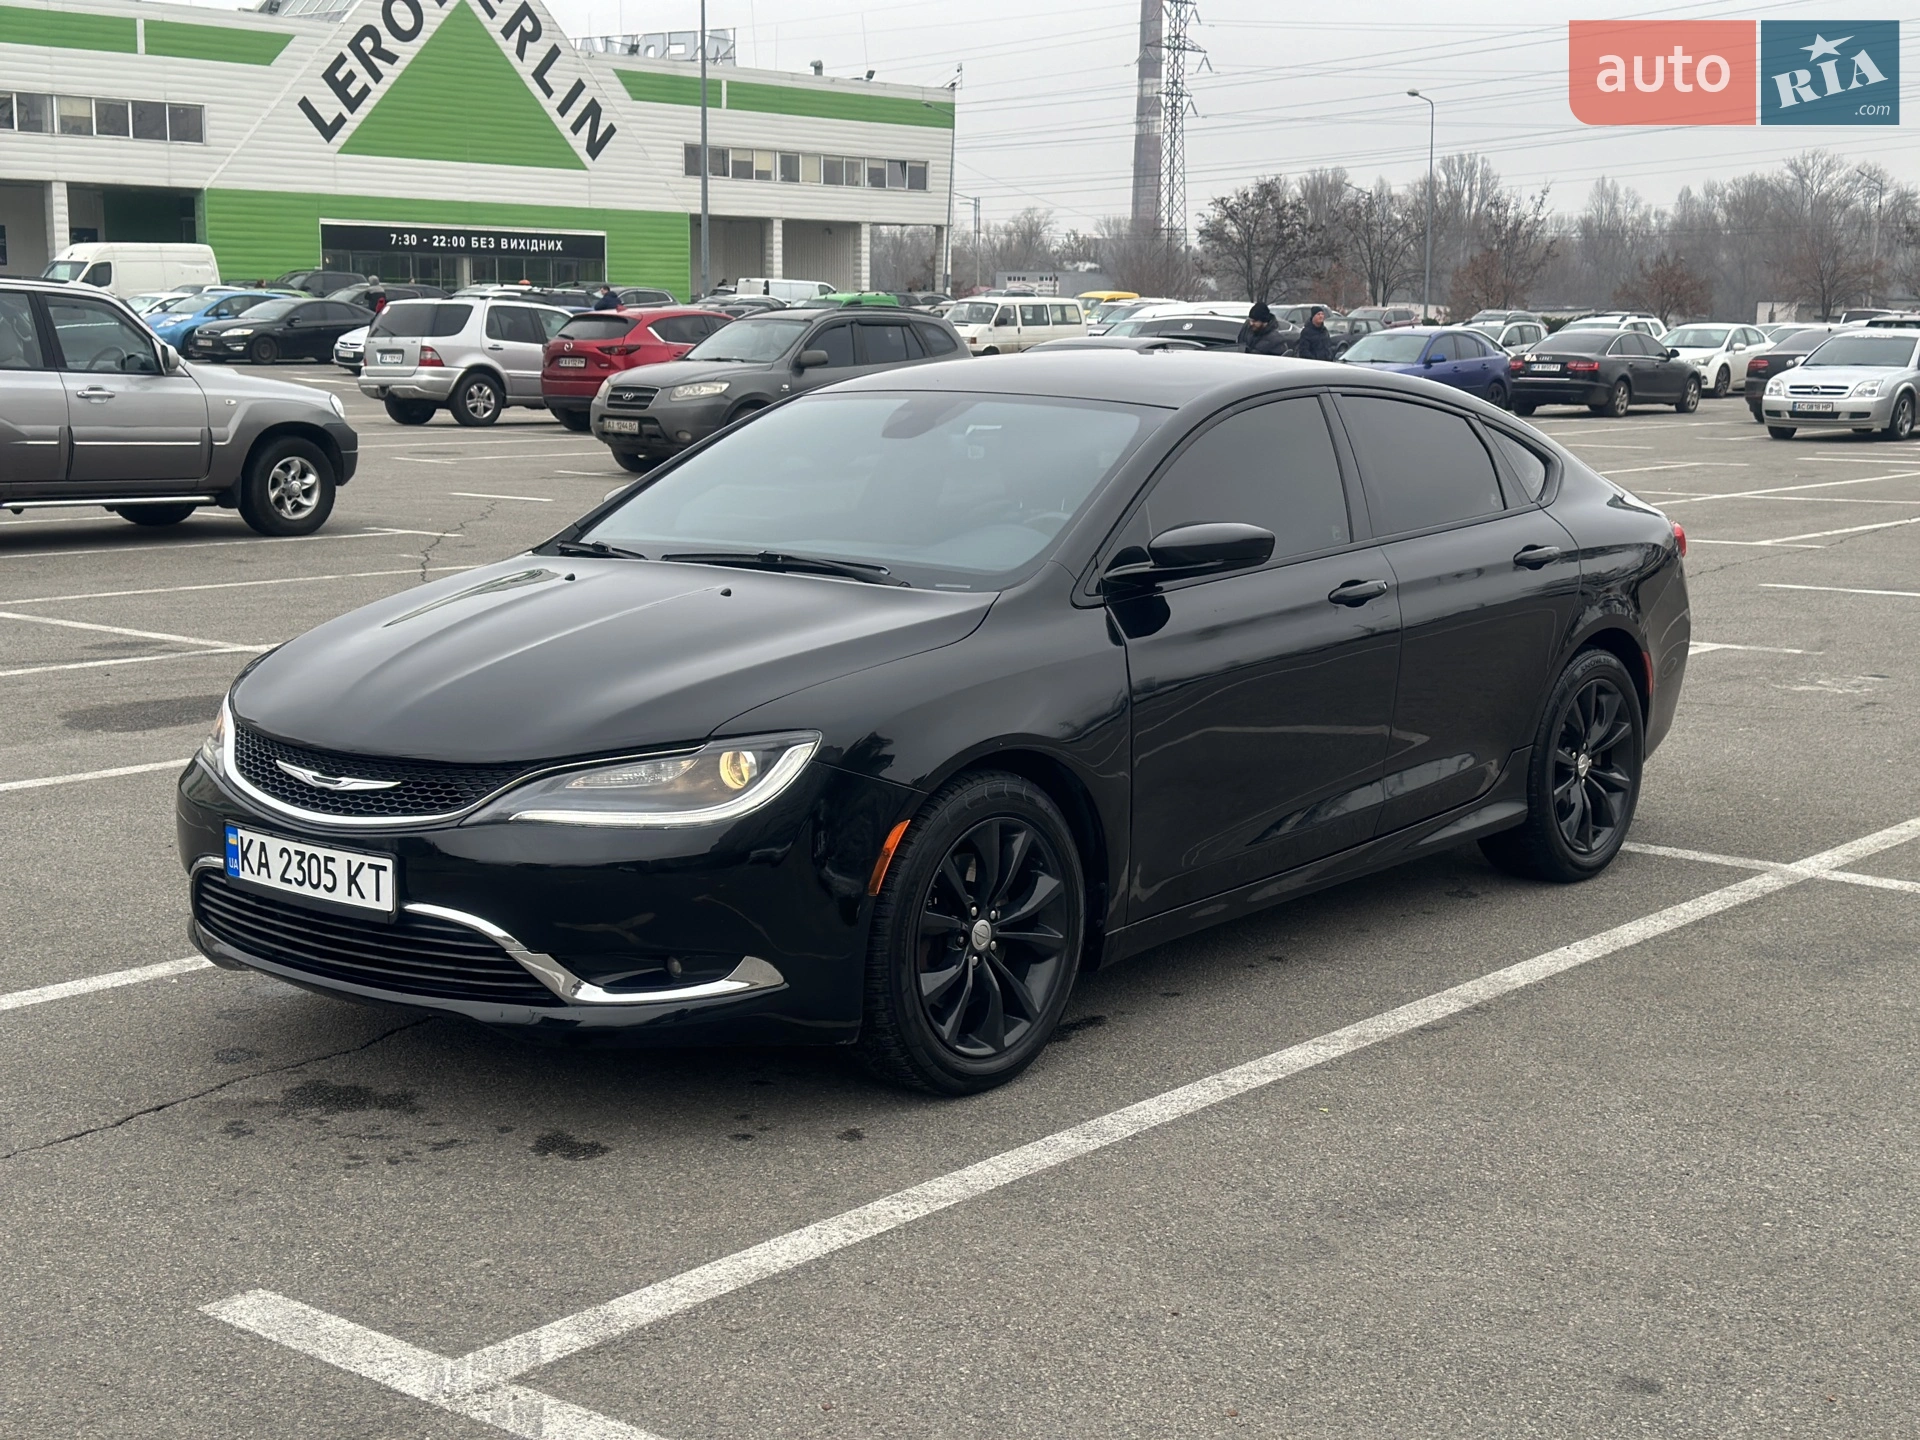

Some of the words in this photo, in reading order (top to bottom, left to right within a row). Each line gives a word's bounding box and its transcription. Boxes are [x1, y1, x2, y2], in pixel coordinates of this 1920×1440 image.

[390, 233, 418, 246] 7:30
[432, 235, 466, 248] 22:00
[471, 237, 496, 249] БЕЗ
[501, 237, 564, 252] ВИХІДНИХ
[229, 857, 239, 870] UA
[239, 836, 271, 879] KA
[279, 847, 337, 893] 2305
[347, 859, 388, 902] KT
